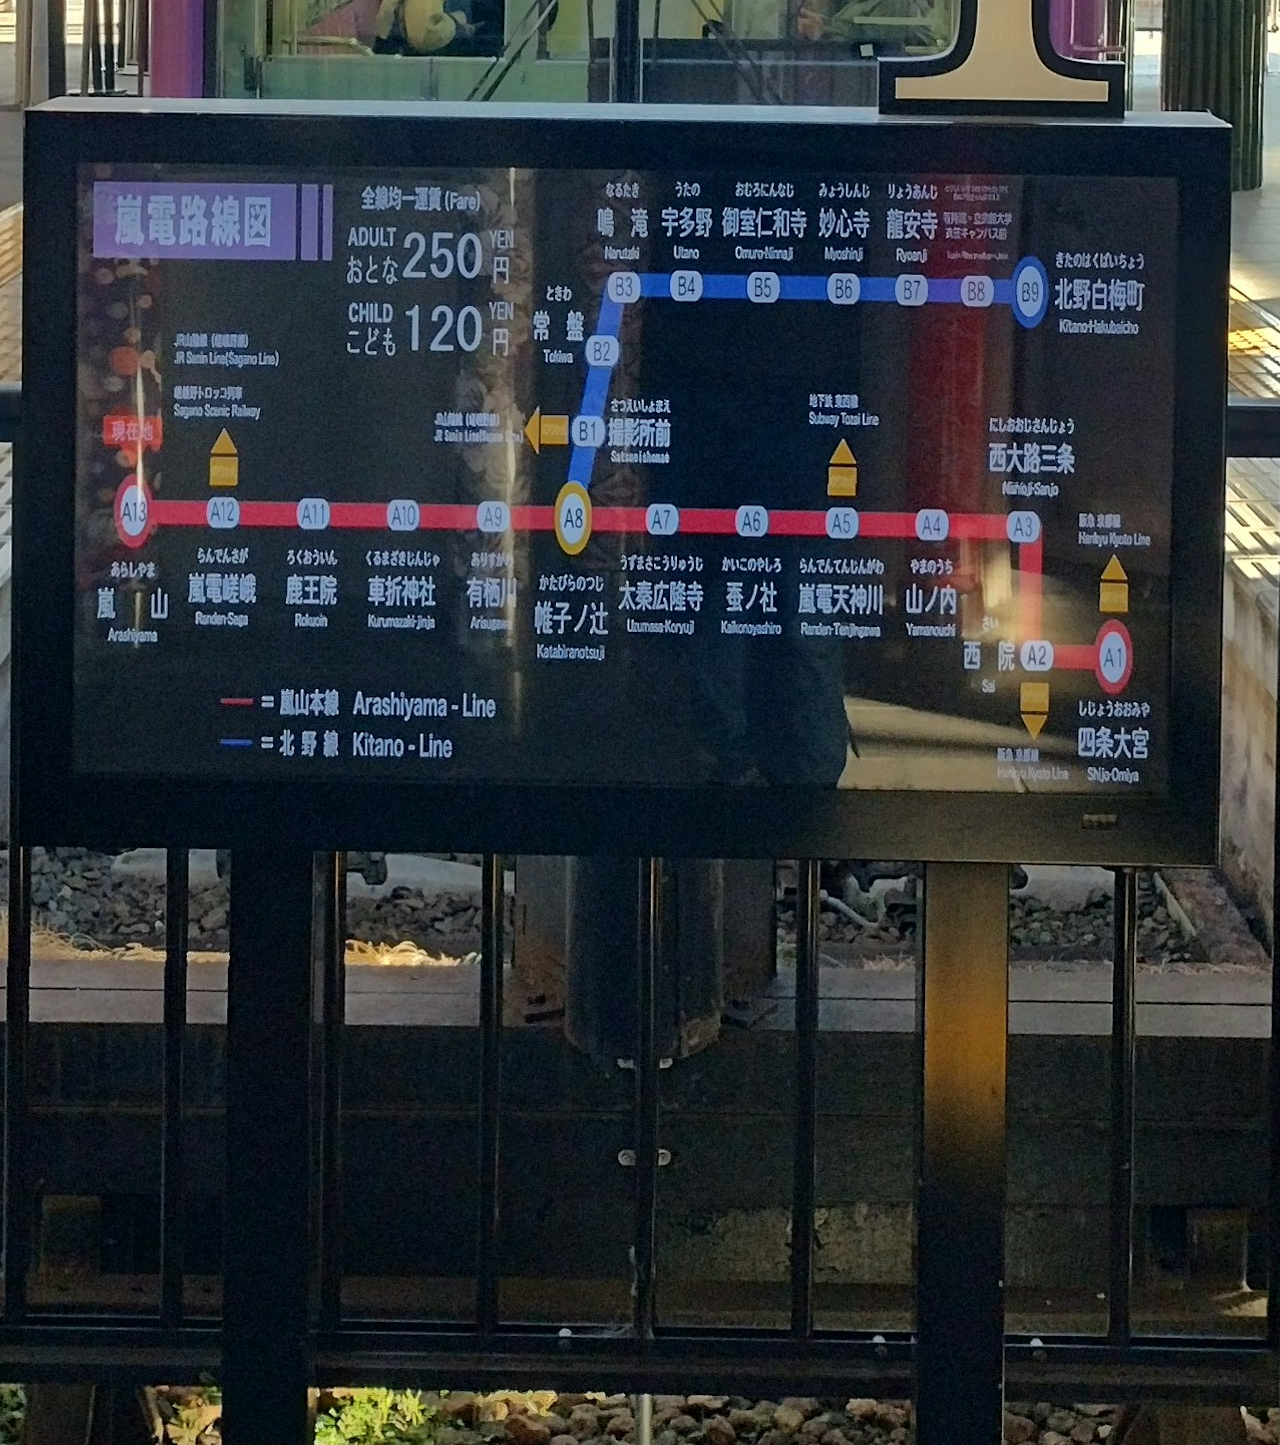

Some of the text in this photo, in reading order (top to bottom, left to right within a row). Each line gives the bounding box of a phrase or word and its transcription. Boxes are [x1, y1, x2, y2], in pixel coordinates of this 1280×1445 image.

[361, 185, 481, 212] 全線均一運賃 (Fare)
[606, 182, 640, 199] なるたき
[675, 181, 701, 197] うたの
[735, 182, 795, 198] おむろにんなじ
[819, 182, 870, 199] みょうしんじ
[888, 183, 938, 200] りょうあんじ
[115, 194, 272, 247] 嵐電路線図
[661, 207, 713, 237] 宇多野
[721, 207, 808, 238] 御室仁和寺
[819, 207, 870, 239] 妙心寺
[886, 208, 939, 240] 龍安寺
[347, 227, 514, 280] ADULT 250 YEN
[673, 245, 700, 258] Utano
[824, 247, 864, 262] Myoshinji
[896, 248, 928, 263] Ryoanji
[1055, 251, 1145, 270] きたのはくばいちょう
[346, 255, 510, 285] おとな 円
[545, 285, 572, 302] ときわ
[615, 276, 633, 296] B3
[678, 276, 695, 296] B4
[754, 277, 772, 297] B5
[835, 279, 853, 299] B6
[903, 280, 921, 300] B7
[967, 281, 986, 301] B8
[1021, 282, 1039, 302] B9
[1055, 278, 1145, 311] 北野白梅町
[348, 301, 514, 352] CHILD 120 YEN
[533, 310, 584, 341] 常盤
[346, 327, 509, 357] こども 円
[593, 341, 611, 361] B2
[543, 349, 573, 364] Tokiwa
[808, 411, 839, 428] Subway
[862, 413, 880, 426] Line
[989, 417, 1075, 434] にしおおじさんじょう
[111, 421, 153, 442] 現在地
[579, 427, 596, 447] B1
[608, 417, 671, 448] 撮影所前
[988, 442, 1076, 474] 西大路三条
[122, 503, 147, 522] A13
[211, 503, 234, 522] A12
[302, 504, 325, 524] A11
[391, 505, 416, 526] A10
[483, 507, 502, 527] A9
[563, 508, 584, 529] A8
[651, 510, 671, 530] A7
[741, 511, 761, 532] A6
[831, 513, 851, 533] A5
[922, 515, 941, 535] A4
[1013, 516, 1033, 537] A3
[197, 548, 249, 564] らんでんさが
[286, 549, 338, 565] ろくおういん
[365, 550, 440, 567] くるまざきじんじゃ
[620, 554, 704, 572] うずまさこうりゅうじ
[721, 556, 782, 573] かいこのやしろ
[110, 561, 156, 578] あらしやま
[799, 558, 885, 575] らんでんてんじんがわ
[910, 559, 953, 575] やまのうち
[188, 573, 256, 604] 嵐電嵯峨
[285, 574, 338, 605] 鹿王院
[368, 575, 436, 607] 車折神社
[466, 577, 517, 609] 有栖川
[539, 574, 604, 592] かたびらのつじ
[97, 587, 169, 619] 嵐山
[618, 580, 704, 612] 太秦広隆寺
[726, 581, 778, 613] 蚕ノ社
[798, 583, 883, 616] 嵐電天神川
[906, 583, 957, 616] 山ノ内
[534, 601, 609, 636] 帷子ノ辻
[721, 619, 782, 637] Kaikonoyashiro
[107, 627, 158, 644] Arashiyama
[905, 622, 956, 638] Yamanouchi
[537, 643, 606, 661] Katabiranotsuji
[963, 641, 1016, 672] 西院
[1027, 645, 1048, 666] A2
[1103, 647, 1123, 668] A1
[981, 678, 996, 694] Sai
[279, 688, 340, 716] 嵐山本線
[352, 691, 448, 721] Arashiyama
[462, 693, 497, 718] Line
[1078, 700, 1151, 718] しじょうおおみや
[278, 729, 340, 757] 北野線
[352, 732, 405, 757] Kitano
[419, 733, 453, 758] Line
[1077, 726, 1150, 759] 四条大宮
[1087, 766, 1140, 784] Shijo-Omiya
